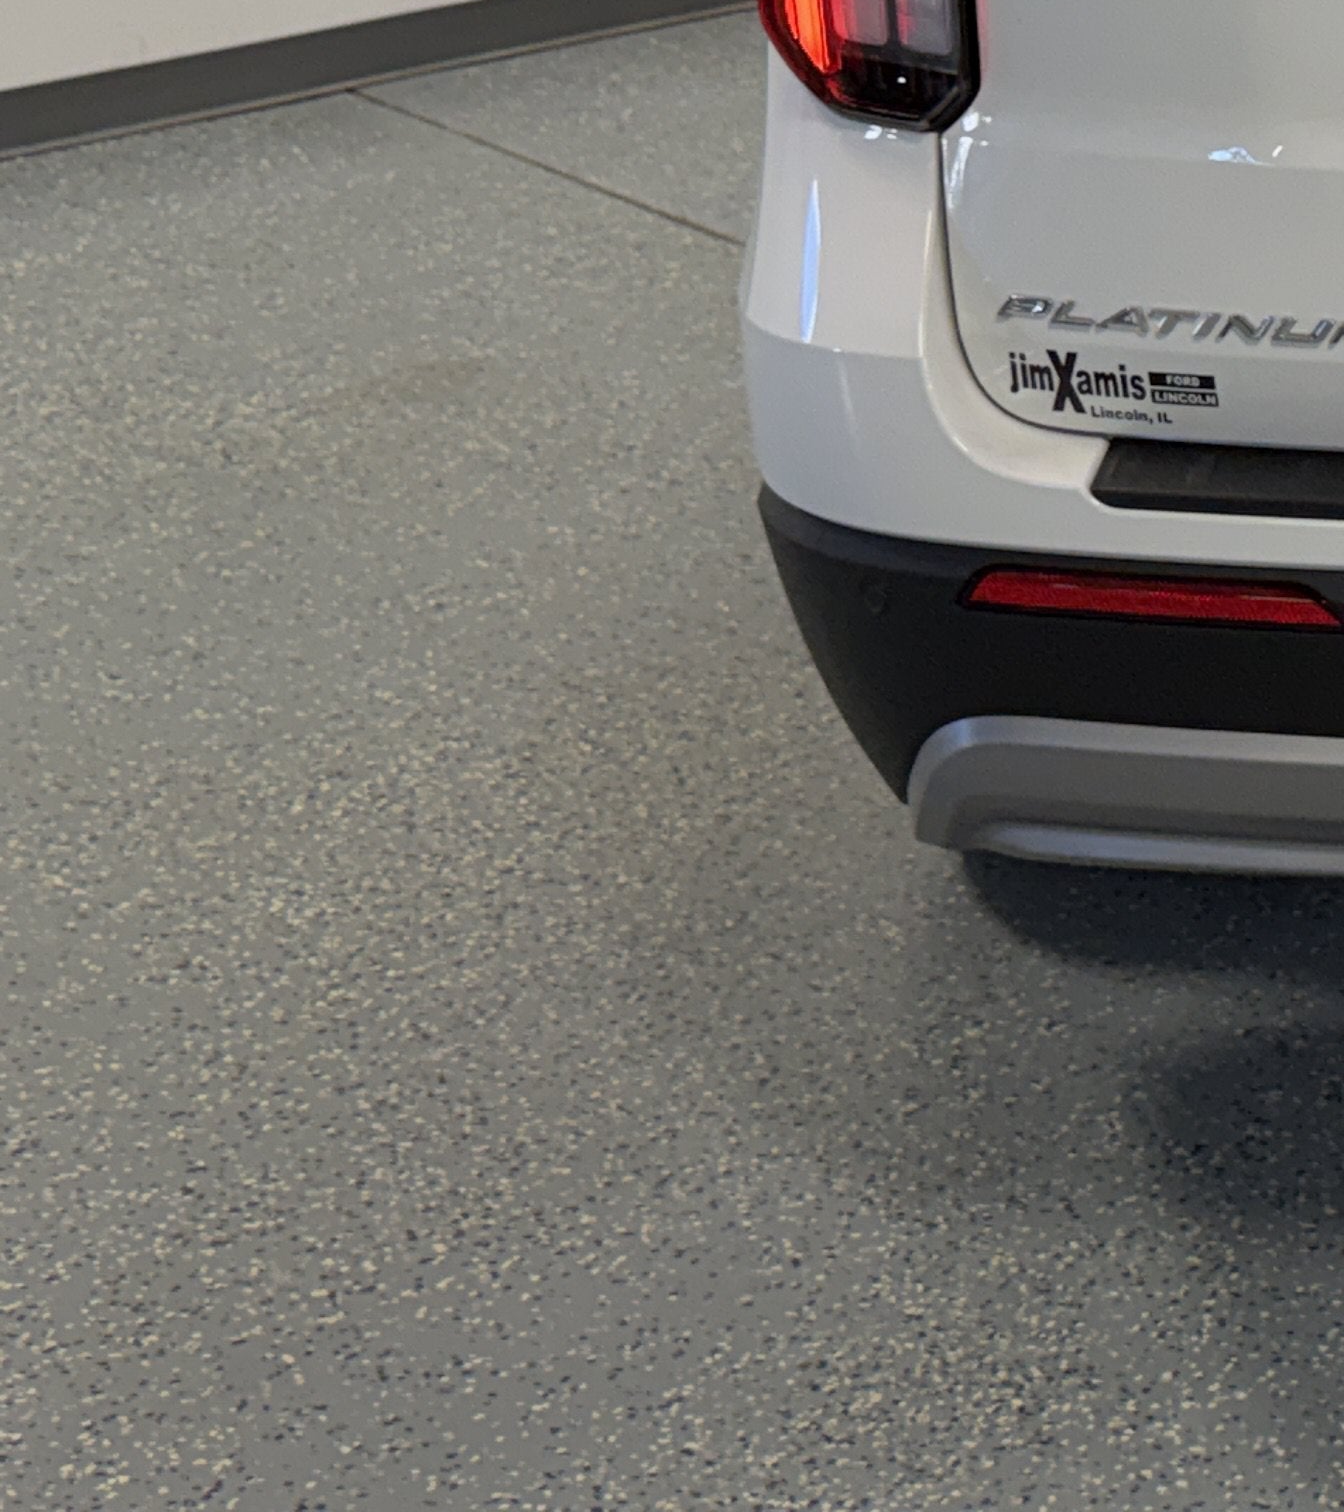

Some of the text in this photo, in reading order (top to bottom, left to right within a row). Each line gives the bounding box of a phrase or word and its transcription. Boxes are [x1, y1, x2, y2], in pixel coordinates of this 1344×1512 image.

[1009, 349, 1146, 414] jimXamis
[1153, 390, 1217, 406] LINCOLN
[1090, 405, 1173, 425] Lincoln, IL
